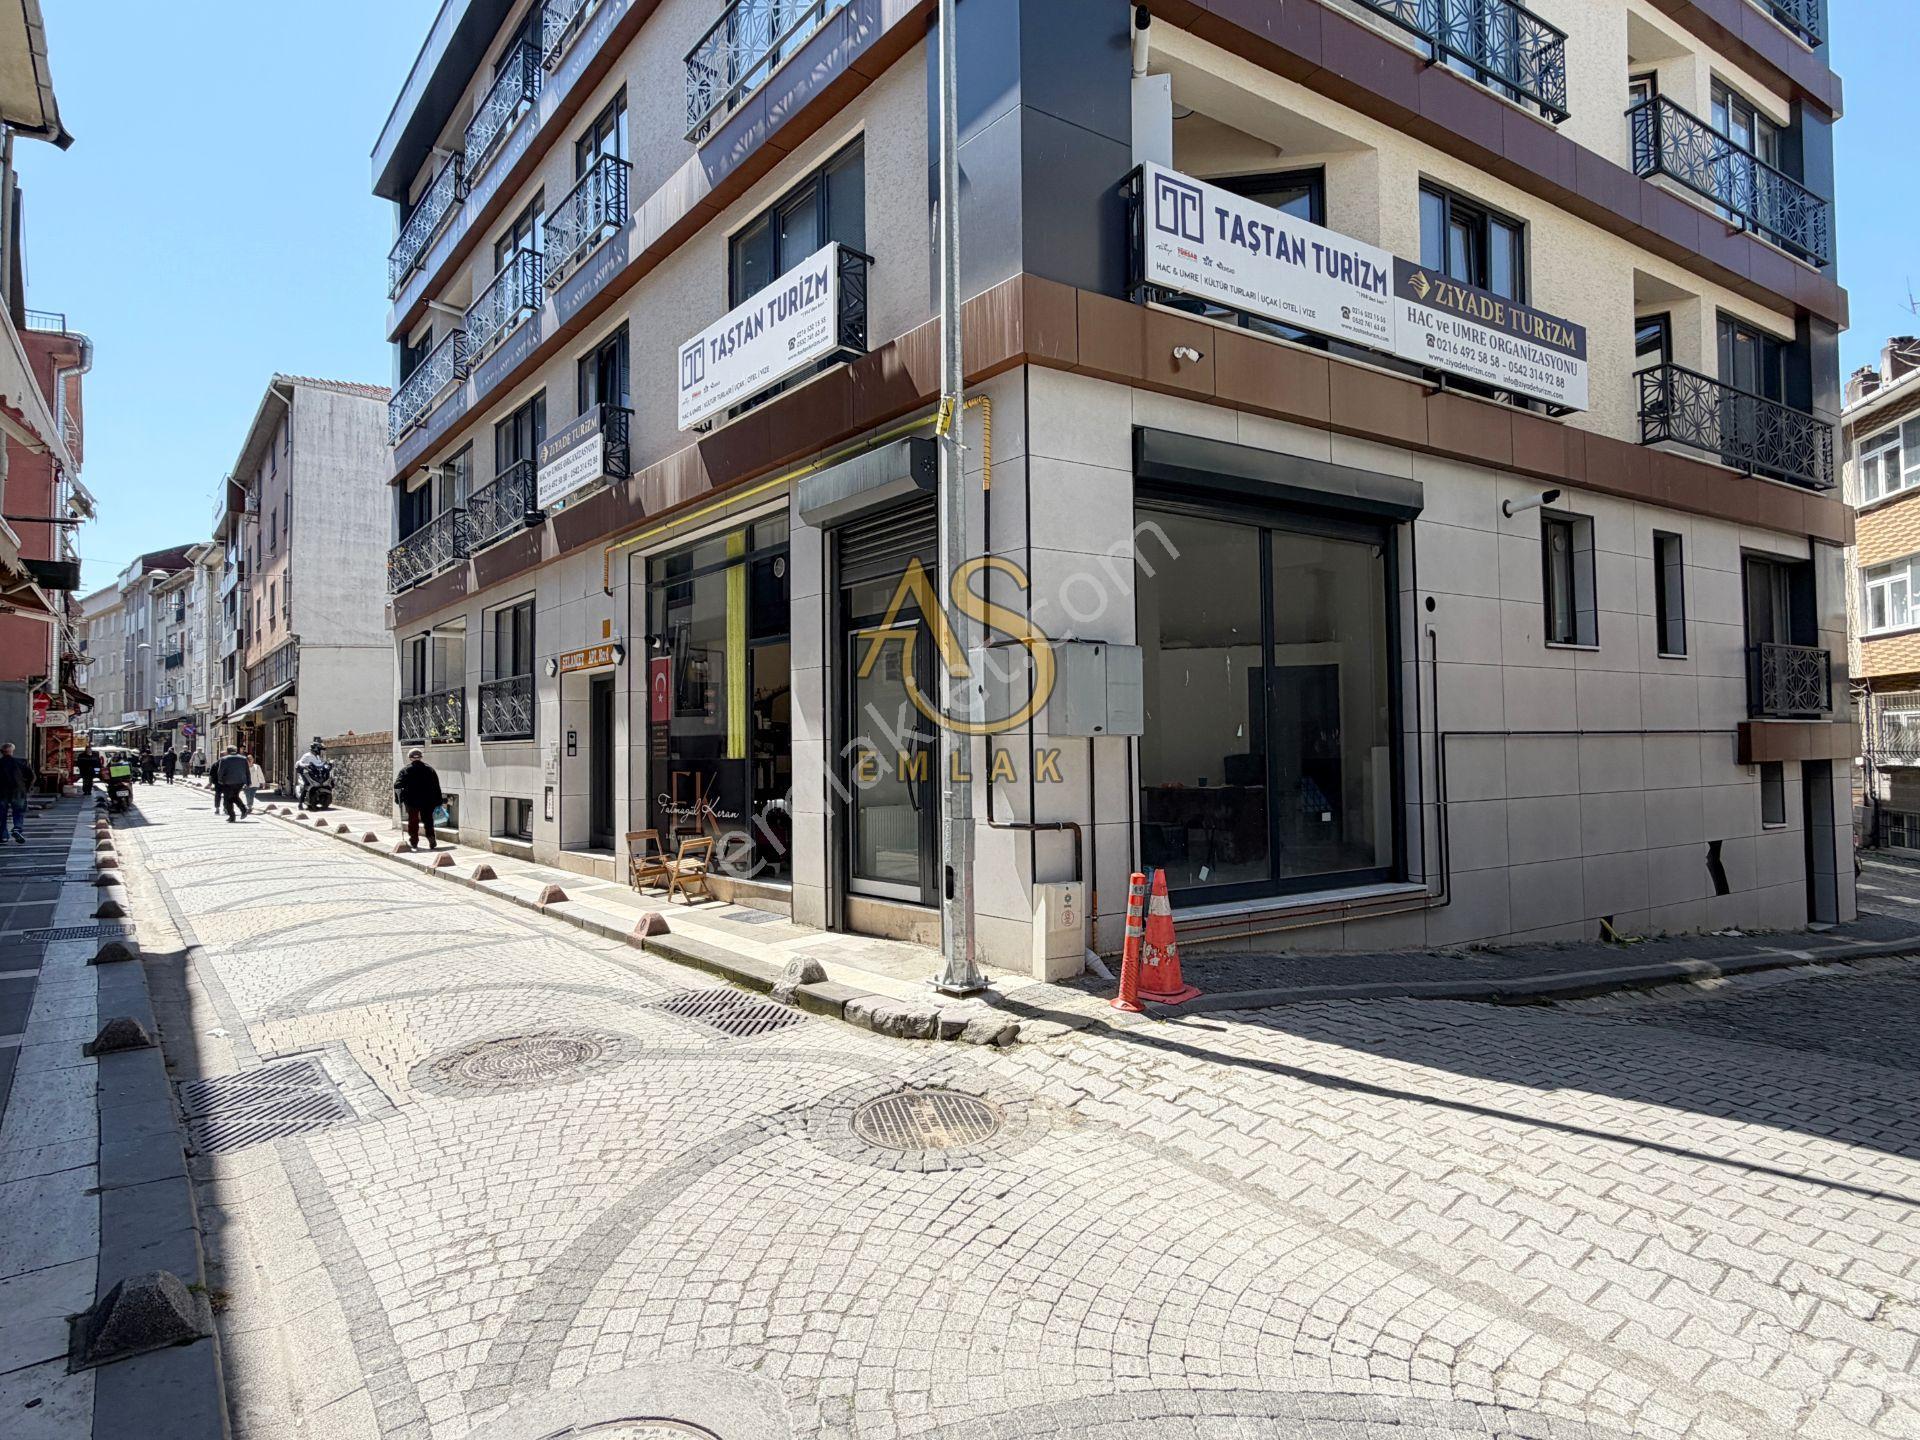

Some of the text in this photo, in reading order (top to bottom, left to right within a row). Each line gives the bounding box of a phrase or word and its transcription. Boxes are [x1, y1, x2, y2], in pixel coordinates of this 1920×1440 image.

[1214, 206, 1388, 296] TAŞTAN TURİZM
[710, 264, 828, 365] TAŞTAN TURİZM
[1156, 261, 1171, 274] HAC
[1180, 269, 1199, 283] UMRE
[1230, 284, 1256, 300] TURLARI
[1261, 295, 1278, 307] UÇAK
[1282, 302, 1298, 313] OTEL
[1407, 306, 1578, 376] HAC ve UMRE ORGANİZASYONU
[1428, 353, 1497, 380] www.ziyadeturizm.com
[1436, 339, 1458, 355] 0216
[1460, 345, 1475, 360] 492
[1478, 350, 1488, 364] 58
[1490, 353, 1500, 368] 58
[1508, 360, 1527, 378] 0542
[1529, 367, 1543, 382] 314
[1545, 372, 1555, 386] 92
[1556, 375, 1565, 389] 88
